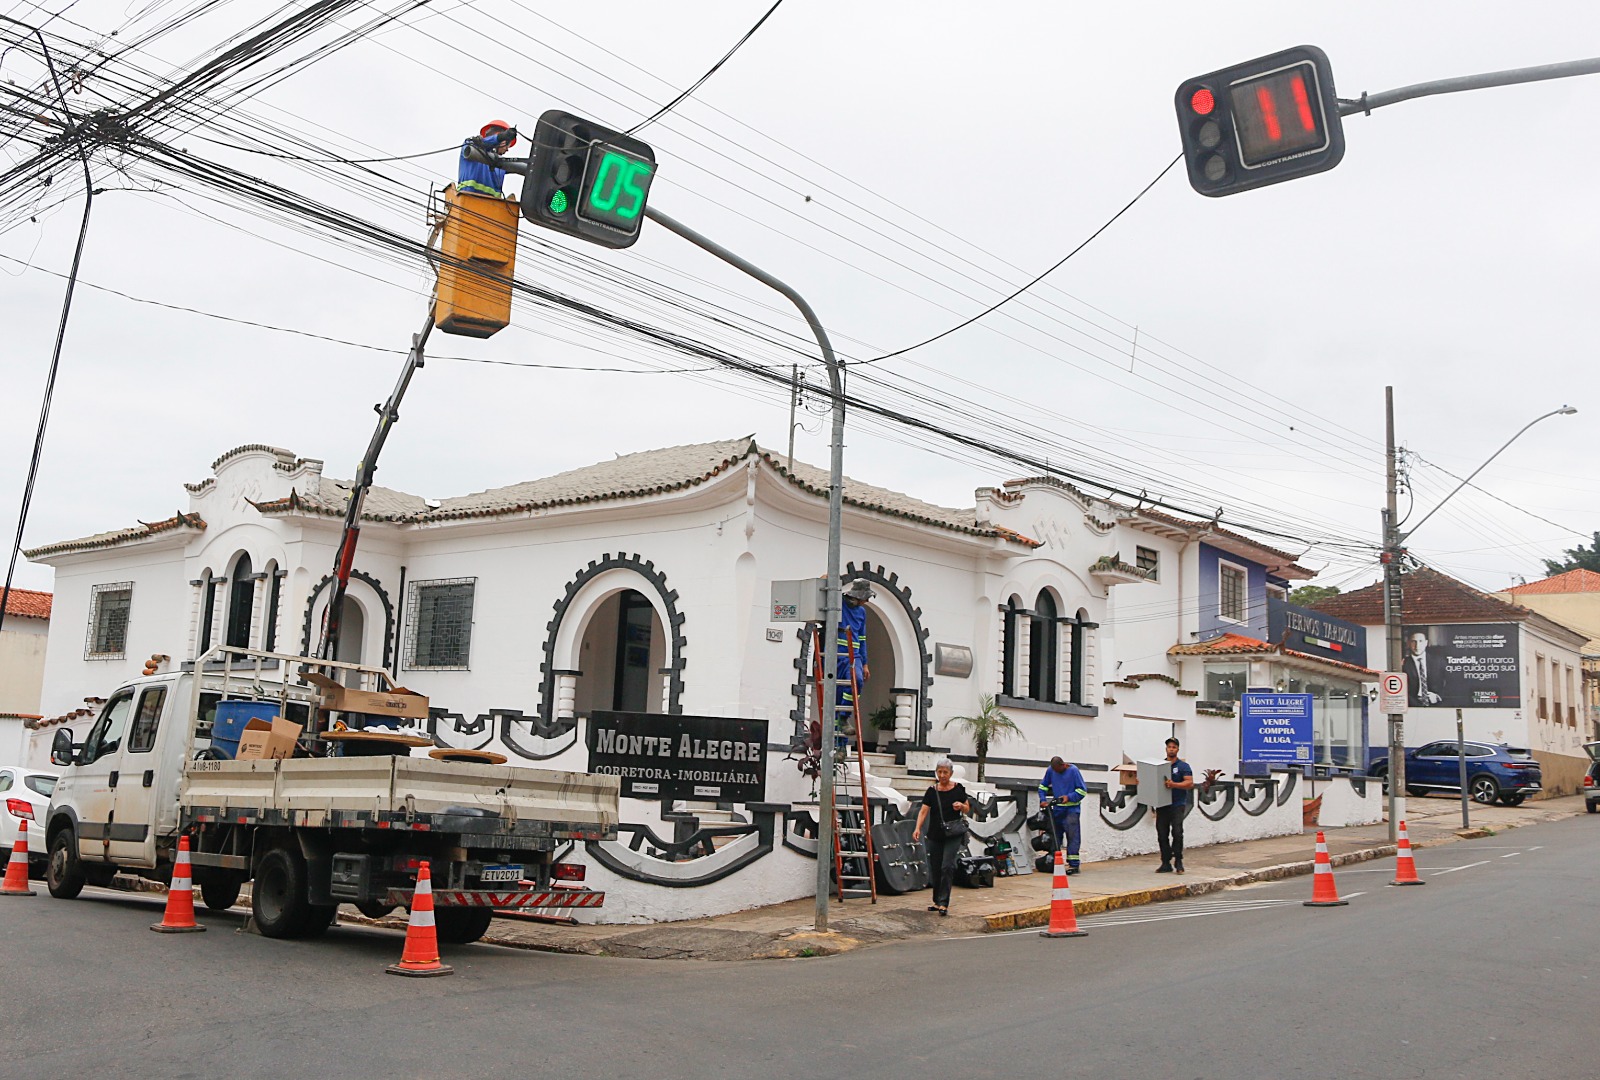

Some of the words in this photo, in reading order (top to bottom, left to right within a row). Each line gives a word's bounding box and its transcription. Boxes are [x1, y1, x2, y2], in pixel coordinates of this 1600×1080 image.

[1256, 76, 1316, 141] 11
[1261, 151, 1311, 167] CONTRANSIN
[589, 151, 652, 219] 05
[1286, 611, 1319, 636] TERNOS
[1323, 622, 1357, 647] TARDIOLI
[1446, 656, 1478, 665] Tardioli,
[1445, 665, 1462, 673] que
[1463, 672, 1498, 681] imagem
[1389, 679, 1398, 690] E
[1249, 697, 1275, 706] MONTE
[1277, 697, 1304, 706] ALEGRE
[1262, 718, 1291, 726] VENDE
[1258, 727, 1296, 735] COMPRA
[1262, 736, 1292, 744] ALUGA
[596, 728, 672, 758] MONTE
[677, 733, 761, 762] ALEGRE
